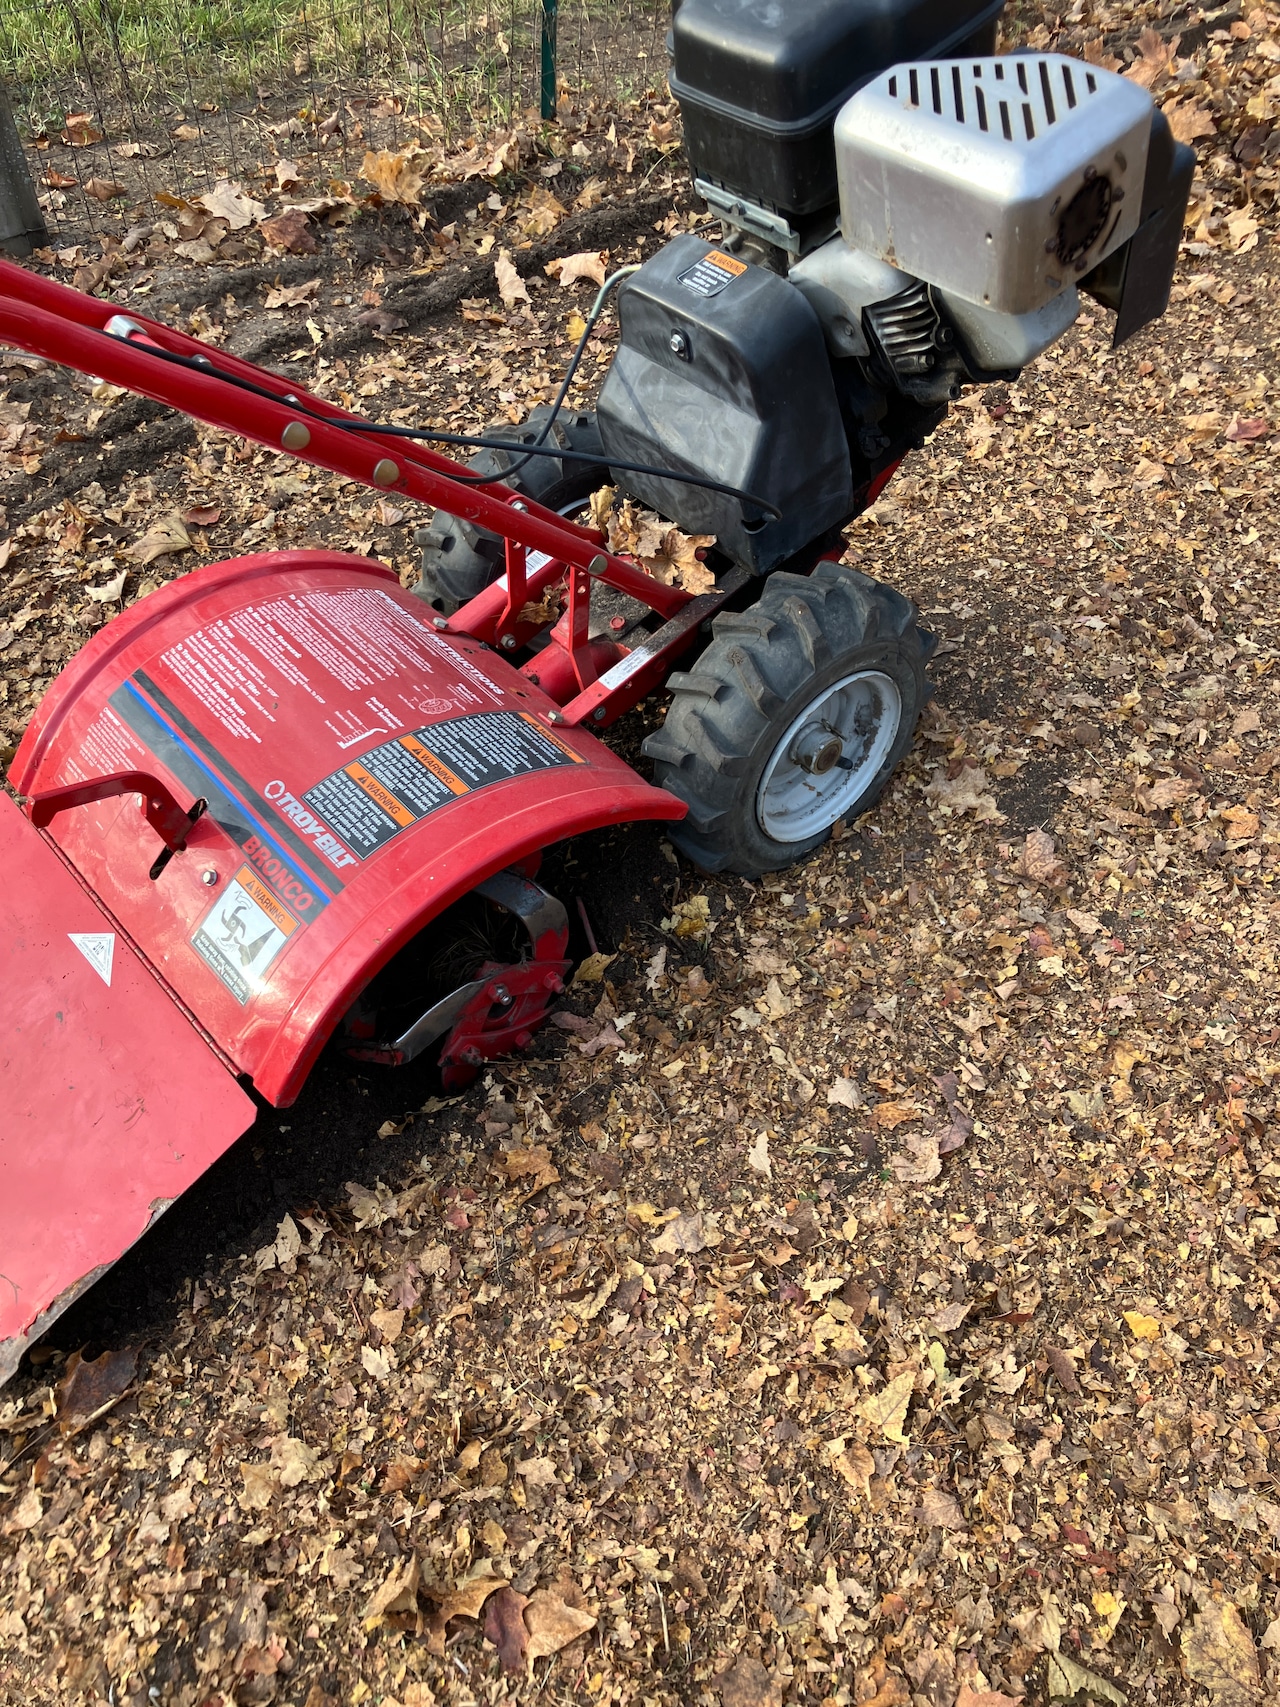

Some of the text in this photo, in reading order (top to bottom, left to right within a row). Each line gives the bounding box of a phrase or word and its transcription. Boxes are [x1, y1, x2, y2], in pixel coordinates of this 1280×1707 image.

[213, 619, 236, 639] To Stop:
[250, 611, 267, 624] Move
[262, 623, 279, 636] Tiller
[372, 588, 430, 633] OPERATING
[425, 632, 504, 695] INSTRUCTIONS
[173, 643, 248, 716] To Travel Without Engine Power:
[194, 630, 262, 696] To Load or Unload Your Tiller:
[364, 700, 380, 712] Lever
[376, 711, 399, 729] Settings:
[368, 696, 385, 709] Depth
[381, 707, 406, 727] Regulator
[387, 764, 404, 777] control
[399, 775, 411, 784] and
[419, 753, 455, 784] WARNING
[323, 778, 340, 794] contact
[335, 791, 351, 805] buried
[360, 815, 372, 826] This
[368, 823, 379, 833] can
[335, 770, 349, 782] Tiller
[344, 779, 357, 790] may
[352, 786, 366, 799] jump
[365, 800, 383, 815] bounce
[342, 787, 355, 798] hard
[350, 795, 367, 810] ground
[369, 814, 383, 826] tines
[365, 781, 400, 814] WARNING
[275, 793, 356, 868] TROY-BILT
[313, 800, 327, 813] tiller
[321, 809, 334, 820] and
[328, 816, 339, 825] all
[317, 782, 332, 796] result
[331, 797, 343, 807] loss
[342, 808, 359, 823] control
[354, 820, 366, 830] and
[361, 827, 379, 844] serious
[325, 801, 338, 812] loss
[336, 813, 353, 829] control
[240, 834, 316, 914] BRONCO
[253, 886, 286, 925] WARNING
